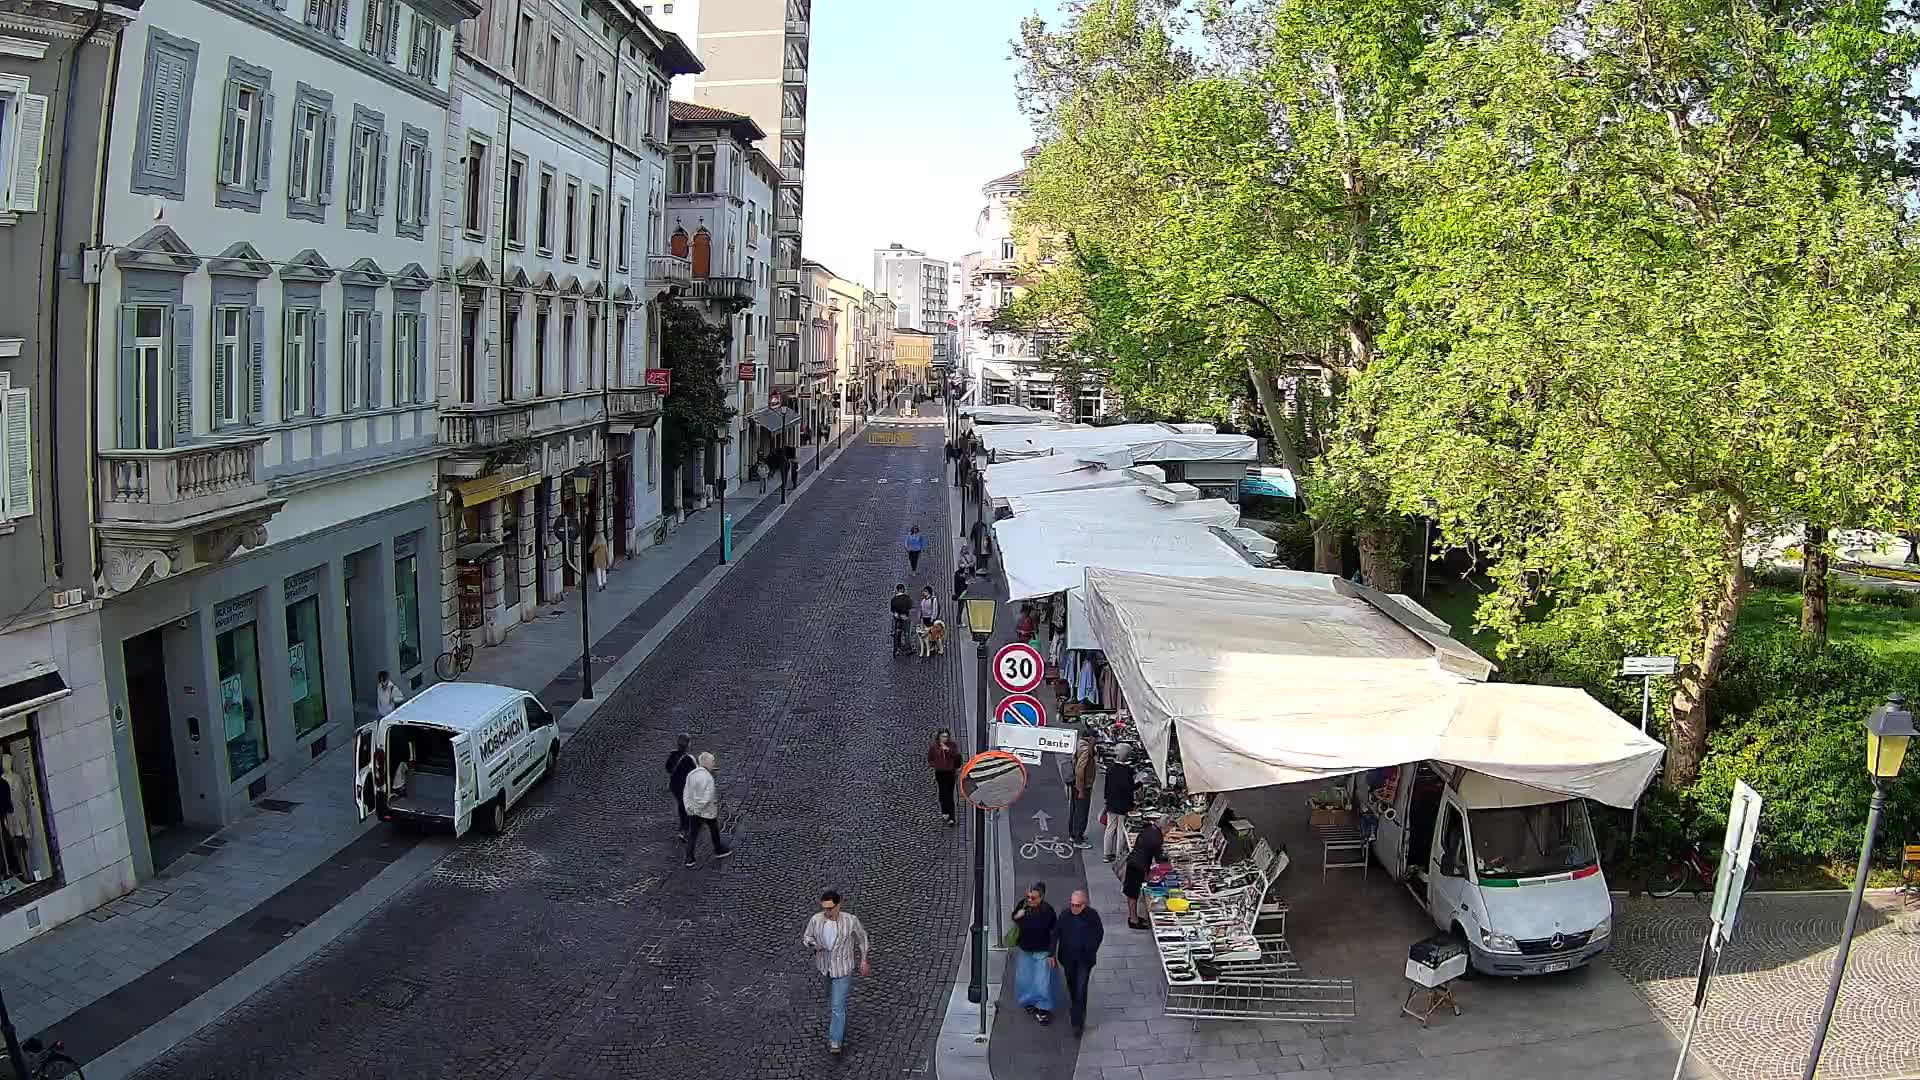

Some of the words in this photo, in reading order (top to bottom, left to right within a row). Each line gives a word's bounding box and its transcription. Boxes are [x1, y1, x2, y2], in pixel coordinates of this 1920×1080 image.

[1005, 657, 1032, 679] 30
[479, 716, 524, 762] MOSCHION
[1039, 738, 1070, 748] Dante
